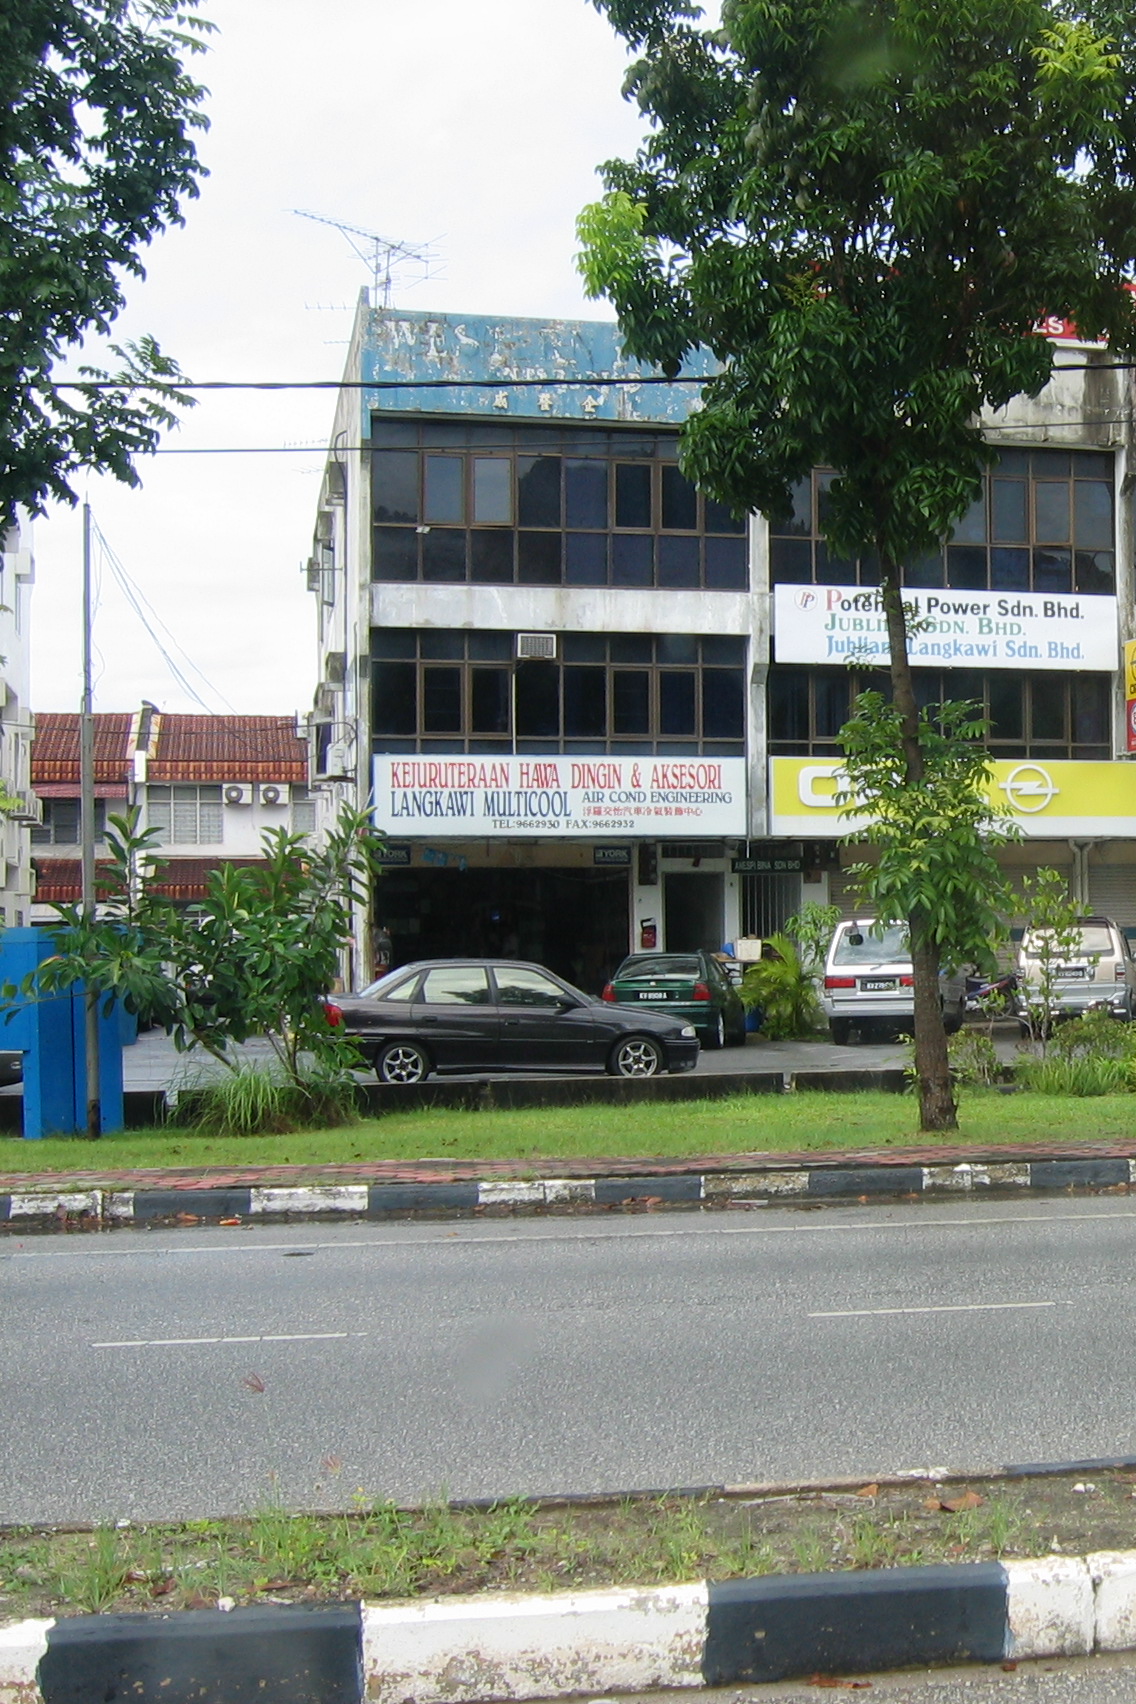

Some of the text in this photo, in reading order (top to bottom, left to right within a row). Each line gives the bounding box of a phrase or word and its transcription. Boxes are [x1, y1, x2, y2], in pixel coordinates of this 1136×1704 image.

[826, 589, 1085, 619] Potenal Power Sdn. Bhd.
[924, 616, 969, 635] SDN.
[978, 617, 1026, 636] BHD.
[907, 637, 998, 659] Langkawi
[1005, 640, 1042, 658] Sdn.
[1047, 641, 1085, 659] Bhd.
[391, 762, 722, 789] KEJURUTERAAN HAWA DINGIN & AKSESORI
[391, 791, 733, 817] LANGKAWI MULTICOOL AIR COND ENGINEERING
